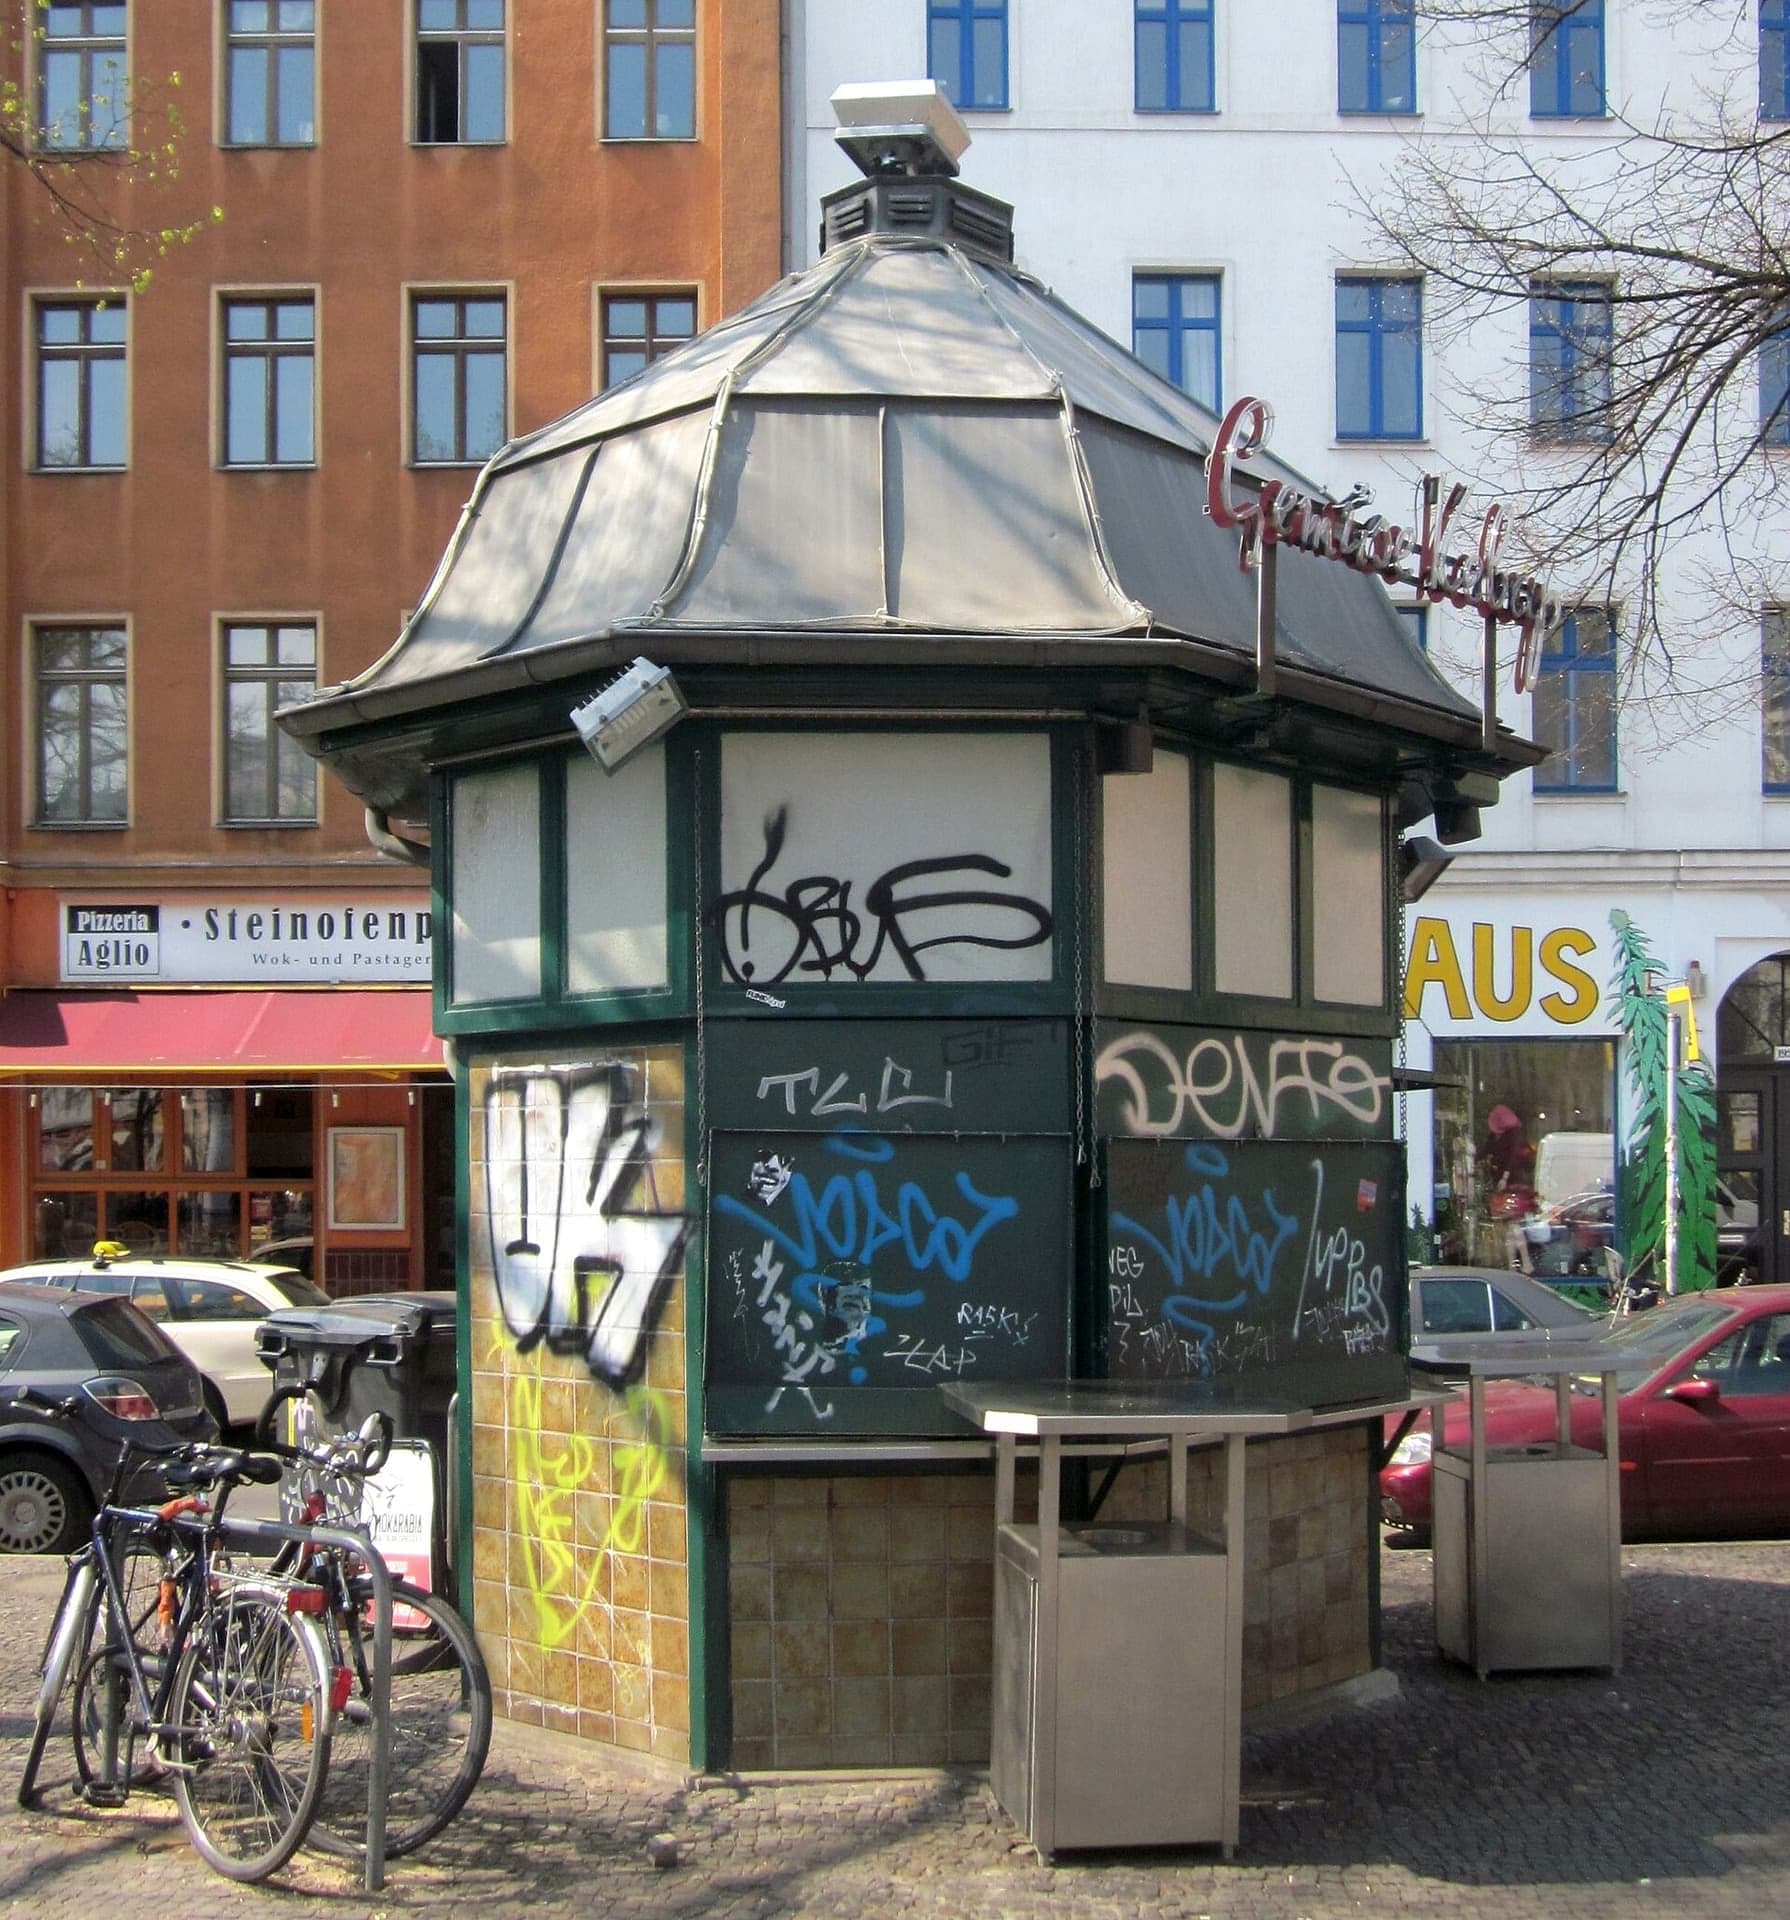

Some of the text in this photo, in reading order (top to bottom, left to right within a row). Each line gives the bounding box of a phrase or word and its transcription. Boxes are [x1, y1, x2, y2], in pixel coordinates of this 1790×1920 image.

[77, 910, 150, 932] Pizzeria
[78, 939, 150, 969] Aglio
[253, 953, 300, 965] Wok-
[309, 953, 342, 965] und
